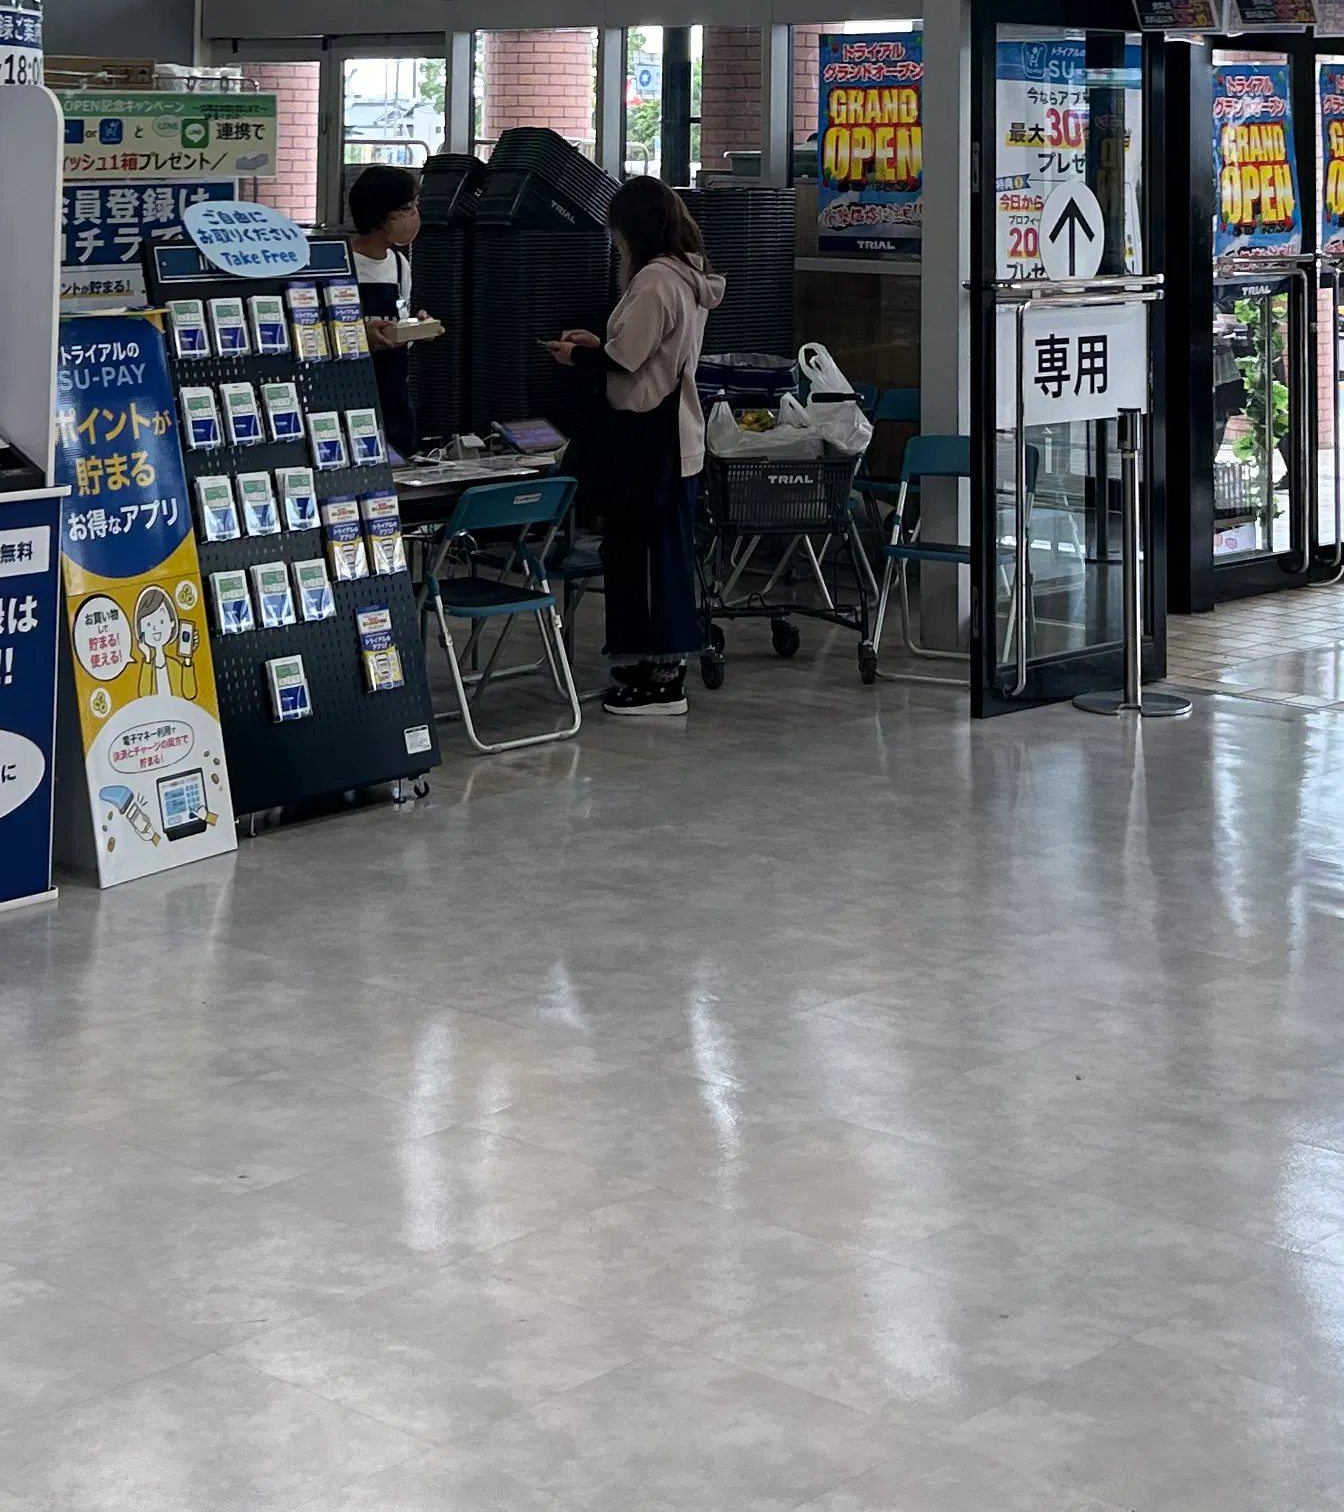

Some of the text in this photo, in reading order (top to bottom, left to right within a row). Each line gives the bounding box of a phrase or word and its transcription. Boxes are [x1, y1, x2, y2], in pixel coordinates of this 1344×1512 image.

[842, 42, 905, 62] トライアル
[823, 62, 924, 83] グランドオープン
[829, 88, 918, 125] GRAND
[134, 125, 144, 139] と
[823, 126, 923, 181] OPEN
[1222, 124, 1286, 163] GRAND
[999, 194, 1044, 212] 今日から
[1221, 164, 1295, 224] OPEN
[202, 209, 268, 225] ご自由に
[197, 227, 298, 244] お取りください
[857, 240, 895, 250] TRIAL
[221, 249, 298, 266] Take Free
[1242, 285, 1272, 296] TRIAL
[60, 342, 140, 366] トライアルの
[1034, 334, 1109, 398] 専用
[58, 363, 146, 390] SU-PAY
[56, 403, 172, 448] ポイントが
[76, 451, 156, 496] 貯まる
[768, 474, 814, 484] TRIAL
[68, 498, 178, 541] お得なアプリ
[0, 541, 33, 564] 無料
[85, 608, 119, 625] お買い物
[88, 633, 122, 652] 貯まる!
[90, 649, 123, 669] 使える!
